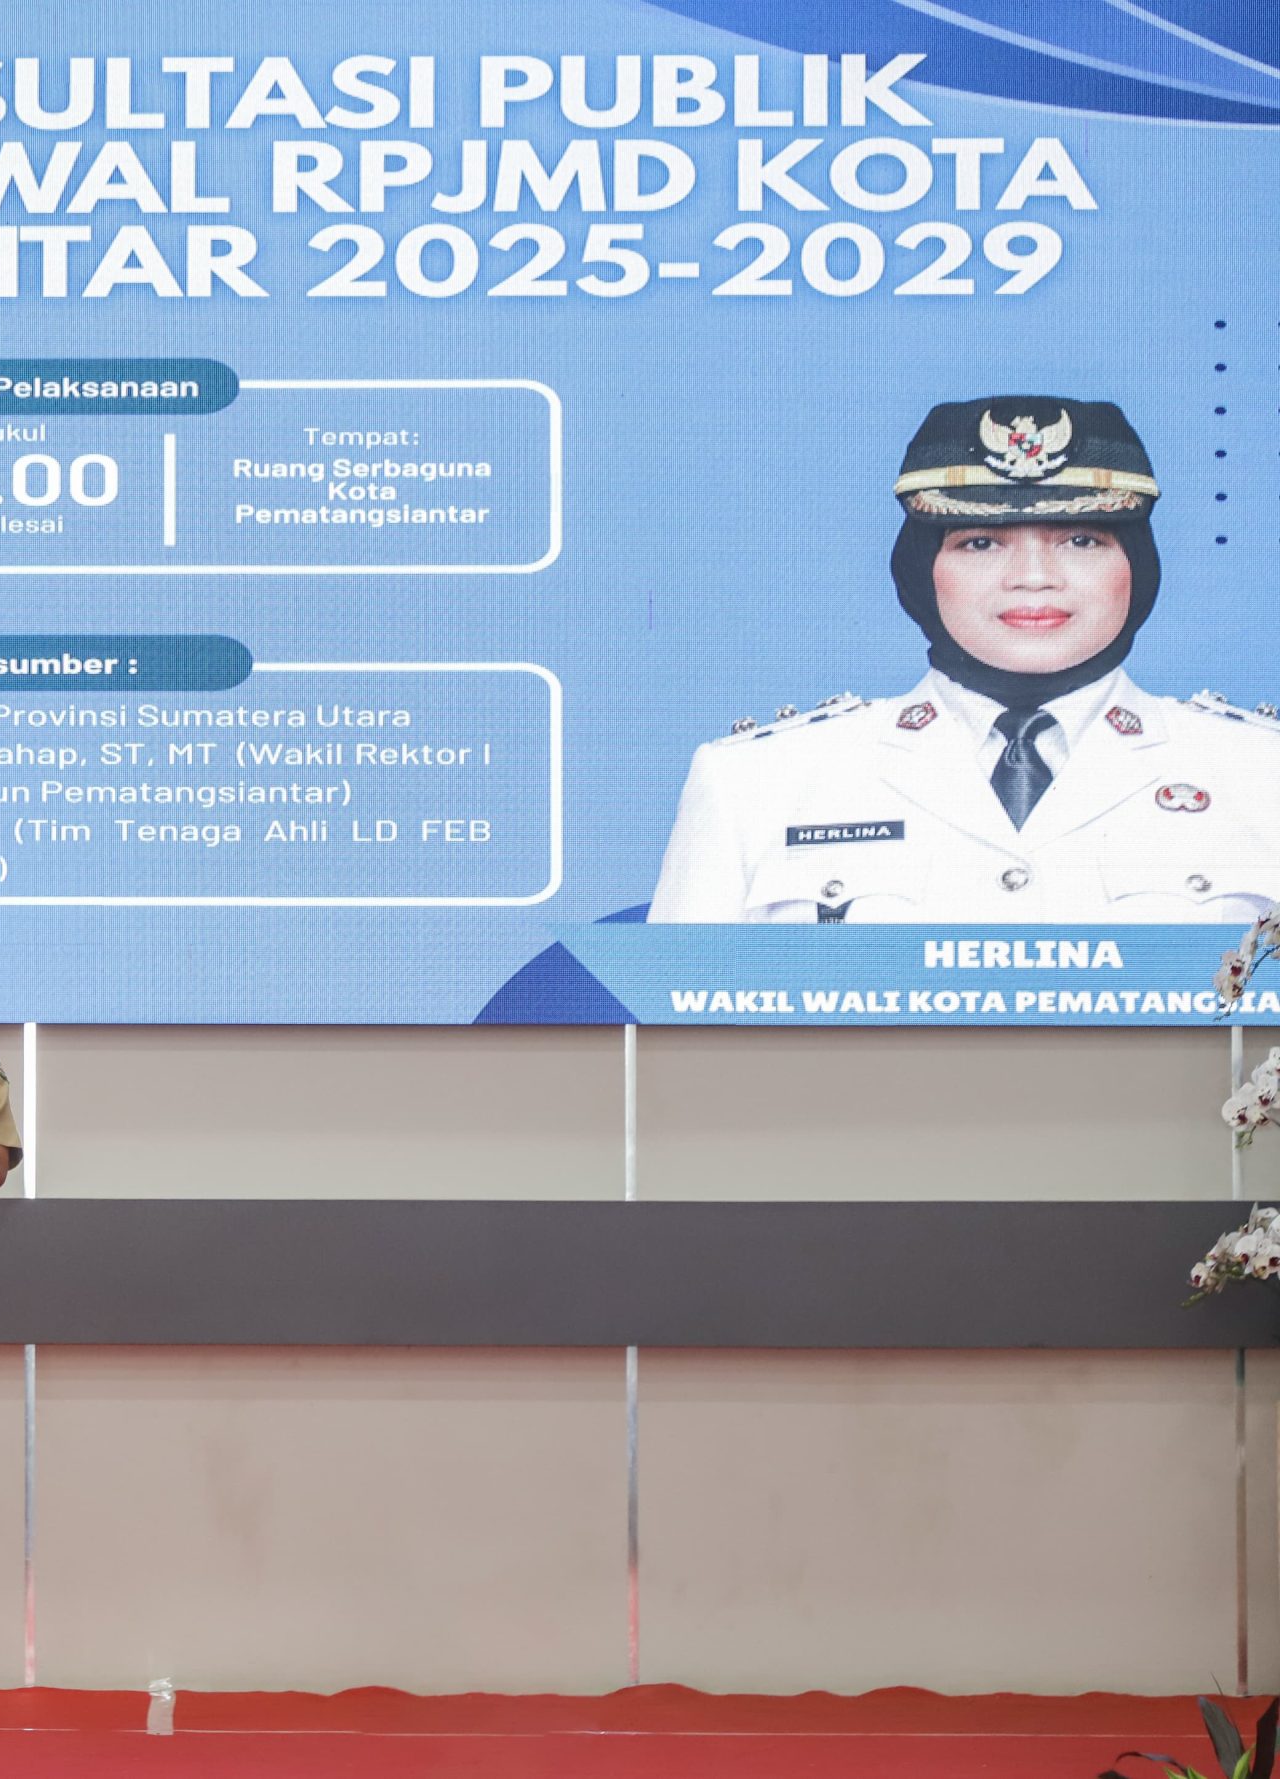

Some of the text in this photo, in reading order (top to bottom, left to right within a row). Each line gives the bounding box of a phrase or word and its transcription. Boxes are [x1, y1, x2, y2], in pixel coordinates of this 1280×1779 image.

[481, 54, 931, 128] PUBLIK
[273, 139, 696, 213] RPJMD
[738, 138, 1097, 211] KOTA
[307, 222, 1062, 297] 2025-2029
[307, 428, 418, 449] Tempat:
[233, 459, 491, 482] Ruang Serbaguna
[327, 482, 397, 501] Kota
[236, 504, 489, 528] Pematangsiantar
[138, 704, 305, 726] Sumatera
[317, 705, 410, 726] Utara
[101, 743, 153, 766] ST,
[169, 743, 215, 765] MT
[236, 741, 342, 767] (Wakil
[356, 743, 470, 765] Rektor
[41, 780, 351, 808] Pematangsiantar)
[14, 818, 91, 844] (Tim
[116, 820, 241, 847] Tenaga
[264, 820, 327, 842] Ahli
[352, 820, 398, 842] LD
[422, 820, 491, 842] FEB
[798, 825, 892, 841] HERLINA
[923, 940, 1124, 969] HERLINA
[670, 990, 795, 1014] WAKIL
[801, 990, 901, 1014] WALI
[908, 990, 1007, 1014] KOTA
